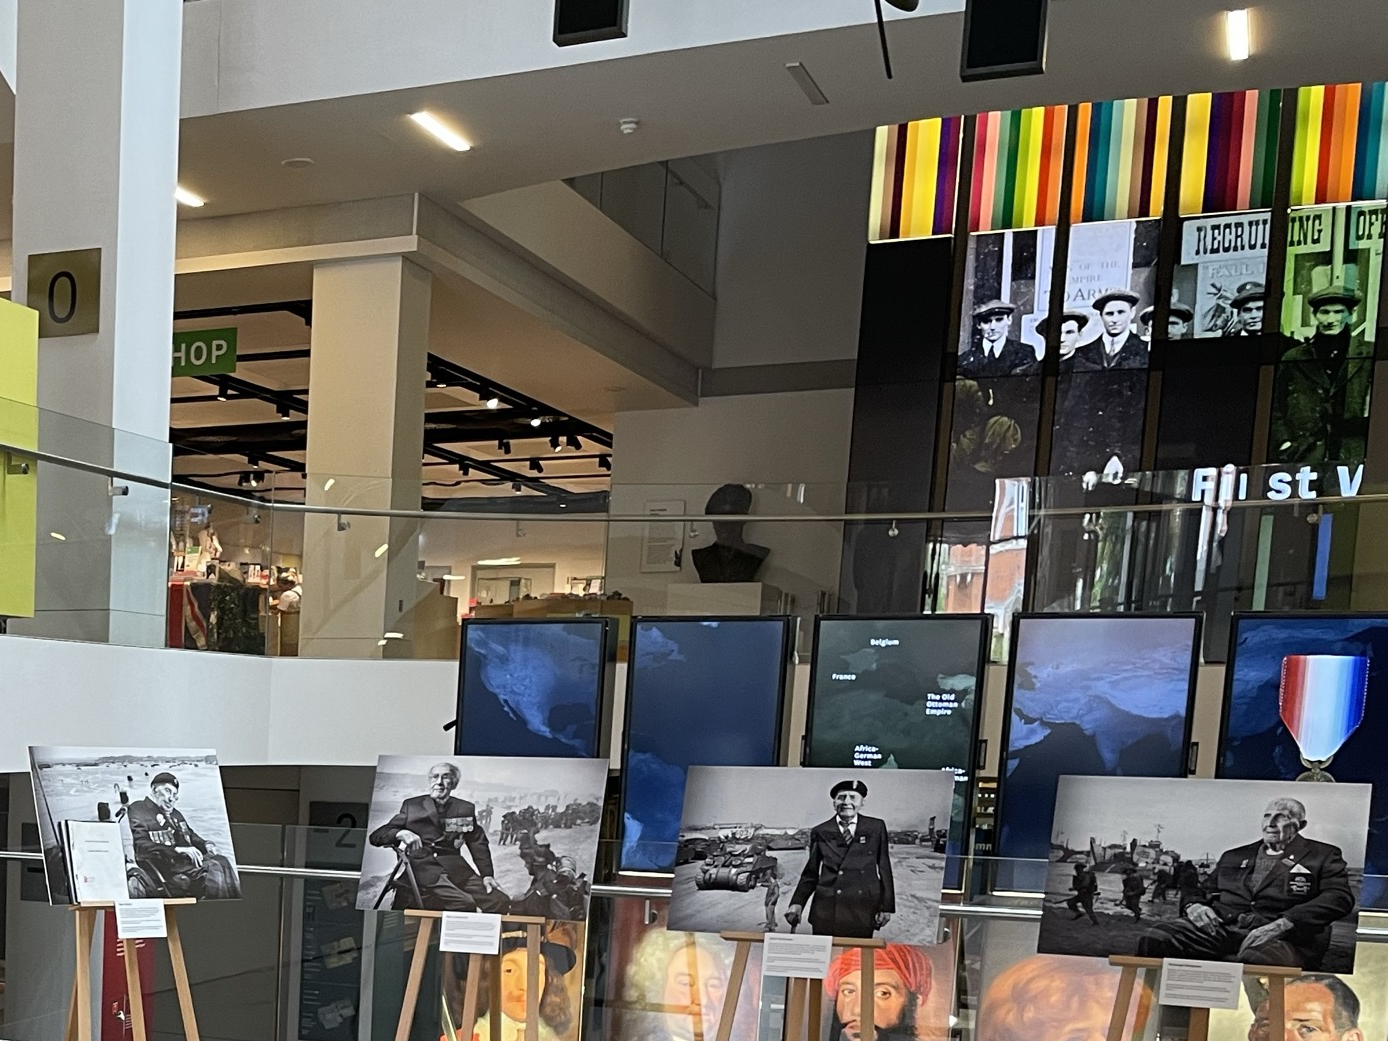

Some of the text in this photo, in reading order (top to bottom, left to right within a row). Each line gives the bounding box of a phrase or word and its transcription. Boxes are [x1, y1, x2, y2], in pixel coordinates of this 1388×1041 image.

[173, 340, 228, 367] HOP
[870, 638, 900, 648] Belgium
[832, 673, 856, 681] France
[927, 693, 955, 701] The Old
[925, 708, 952, 716] Empire
[854, 752, 882, 760] German
[853, 759, 872, 767] West
